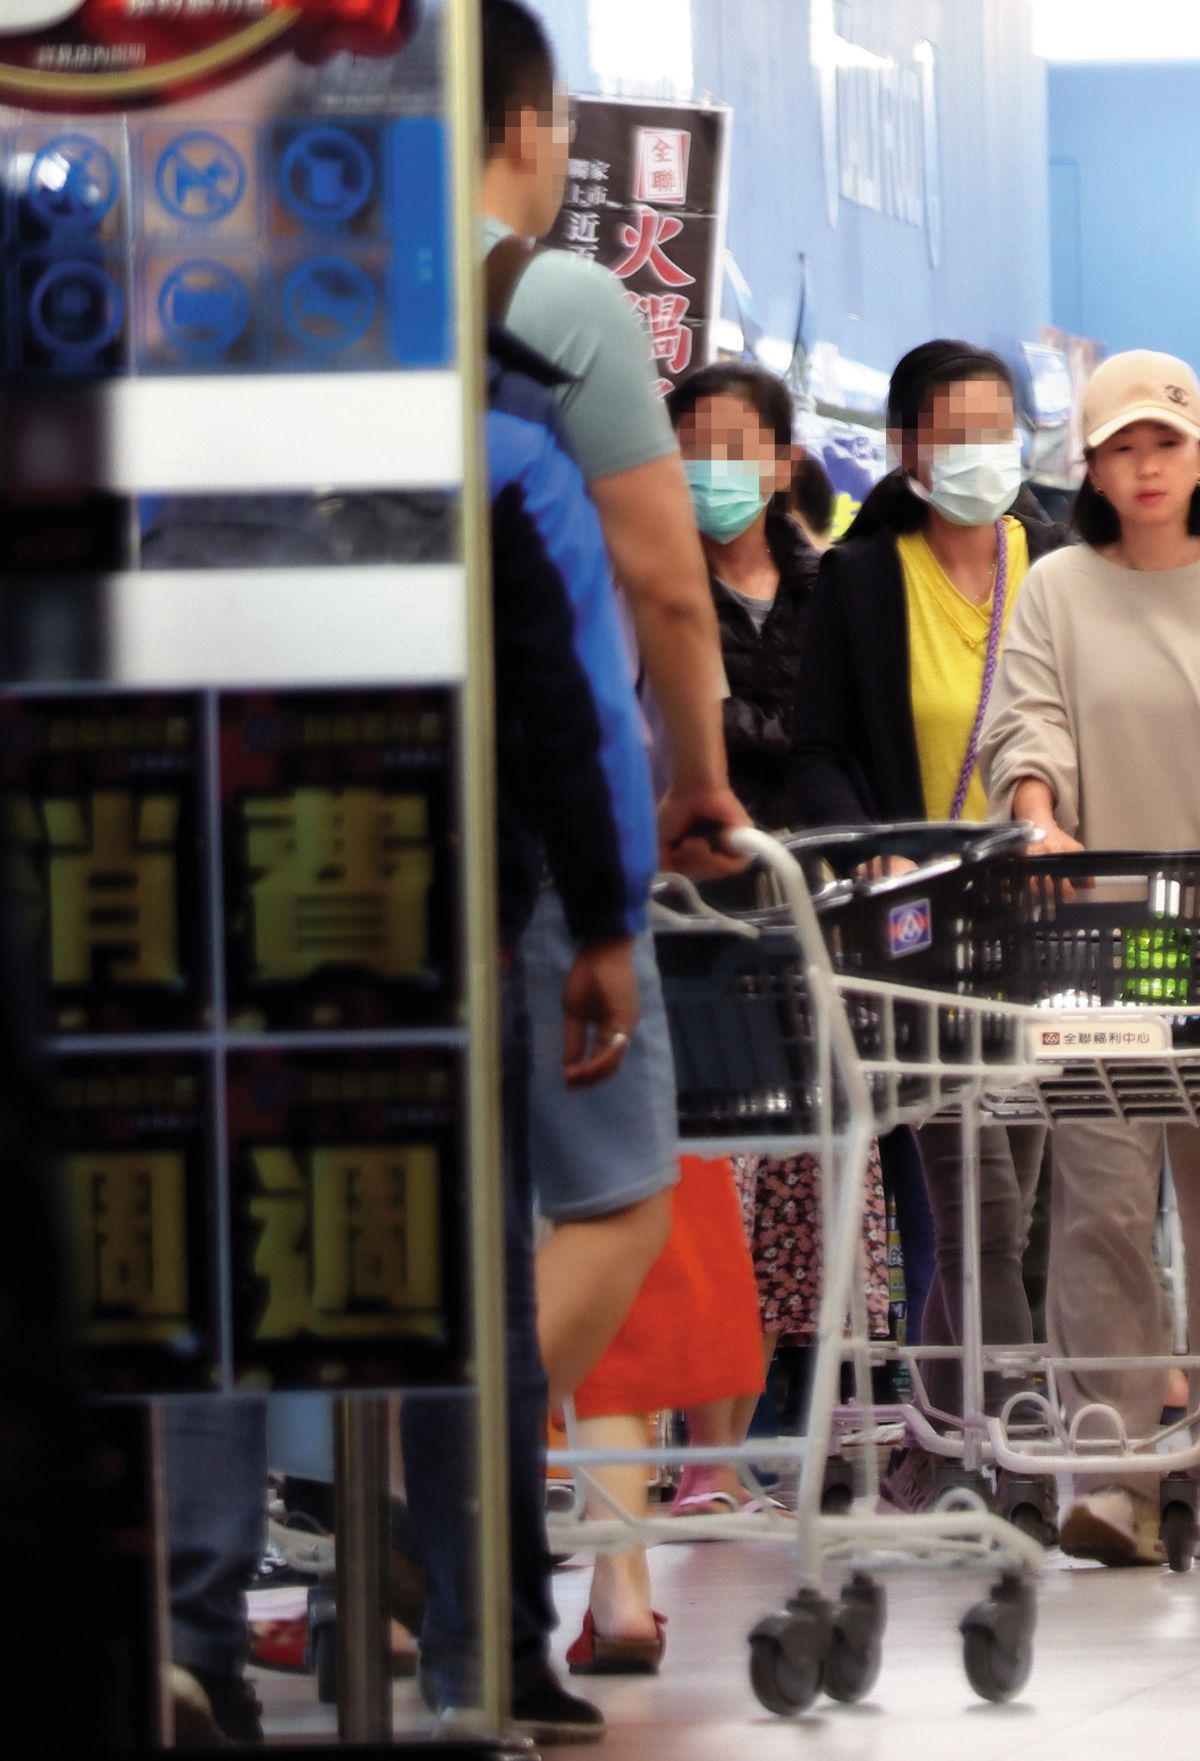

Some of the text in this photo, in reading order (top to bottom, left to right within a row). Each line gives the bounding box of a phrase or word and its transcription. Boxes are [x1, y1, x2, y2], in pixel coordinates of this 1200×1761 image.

[650, 137, 676, 193] 全聯
[610, 204, 697, 398] 火鍋
[1063, 1031, 1151, 1046] 全聯福利中心
